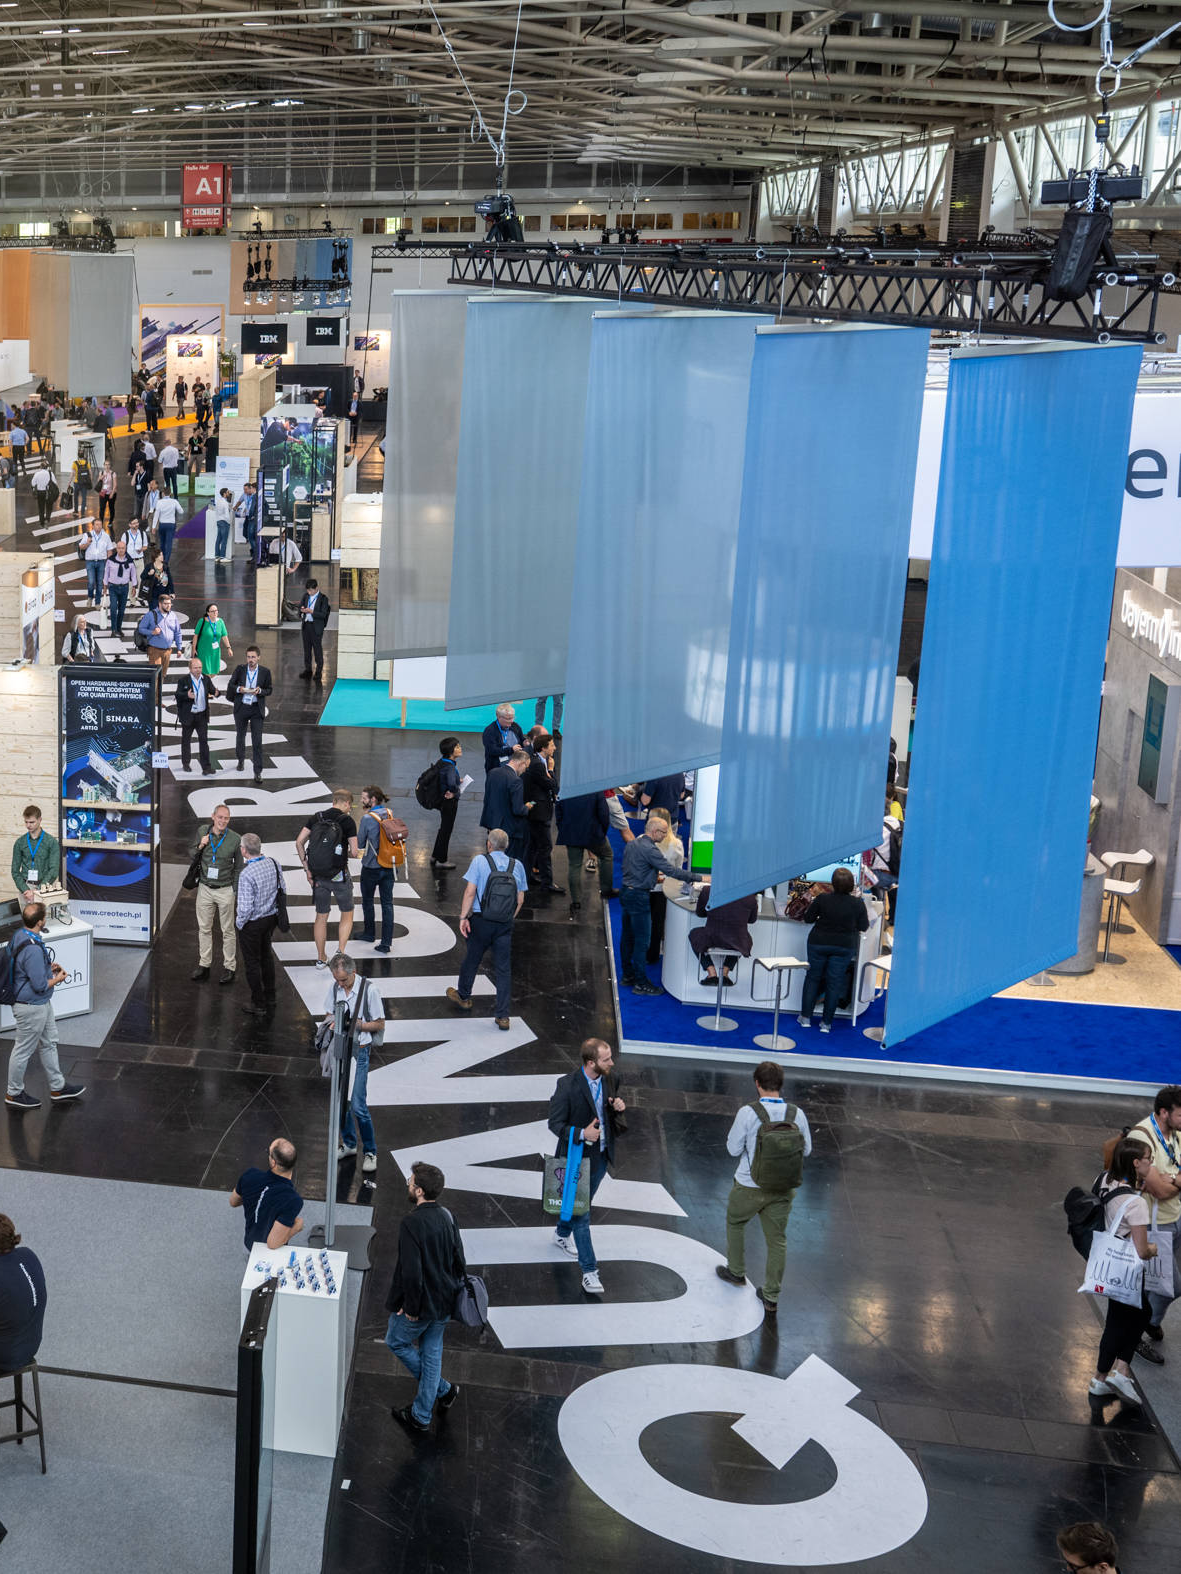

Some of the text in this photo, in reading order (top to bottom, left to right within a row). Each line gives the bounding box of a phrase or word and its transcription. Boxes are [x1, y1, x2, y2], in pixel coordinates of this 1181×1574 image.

[196, 177, 221, 195] A1
[316, 328, 333, 336] IBM
[260, 334, 278, 343] IBM
[1121, 590, 1160, 644] bayern
[87, 680, 150, 688] HARDWARE-SOFTWARE
[106, 715, 140, 723] SINARA
[79, 908, 142, 919] www.creotech.pl
